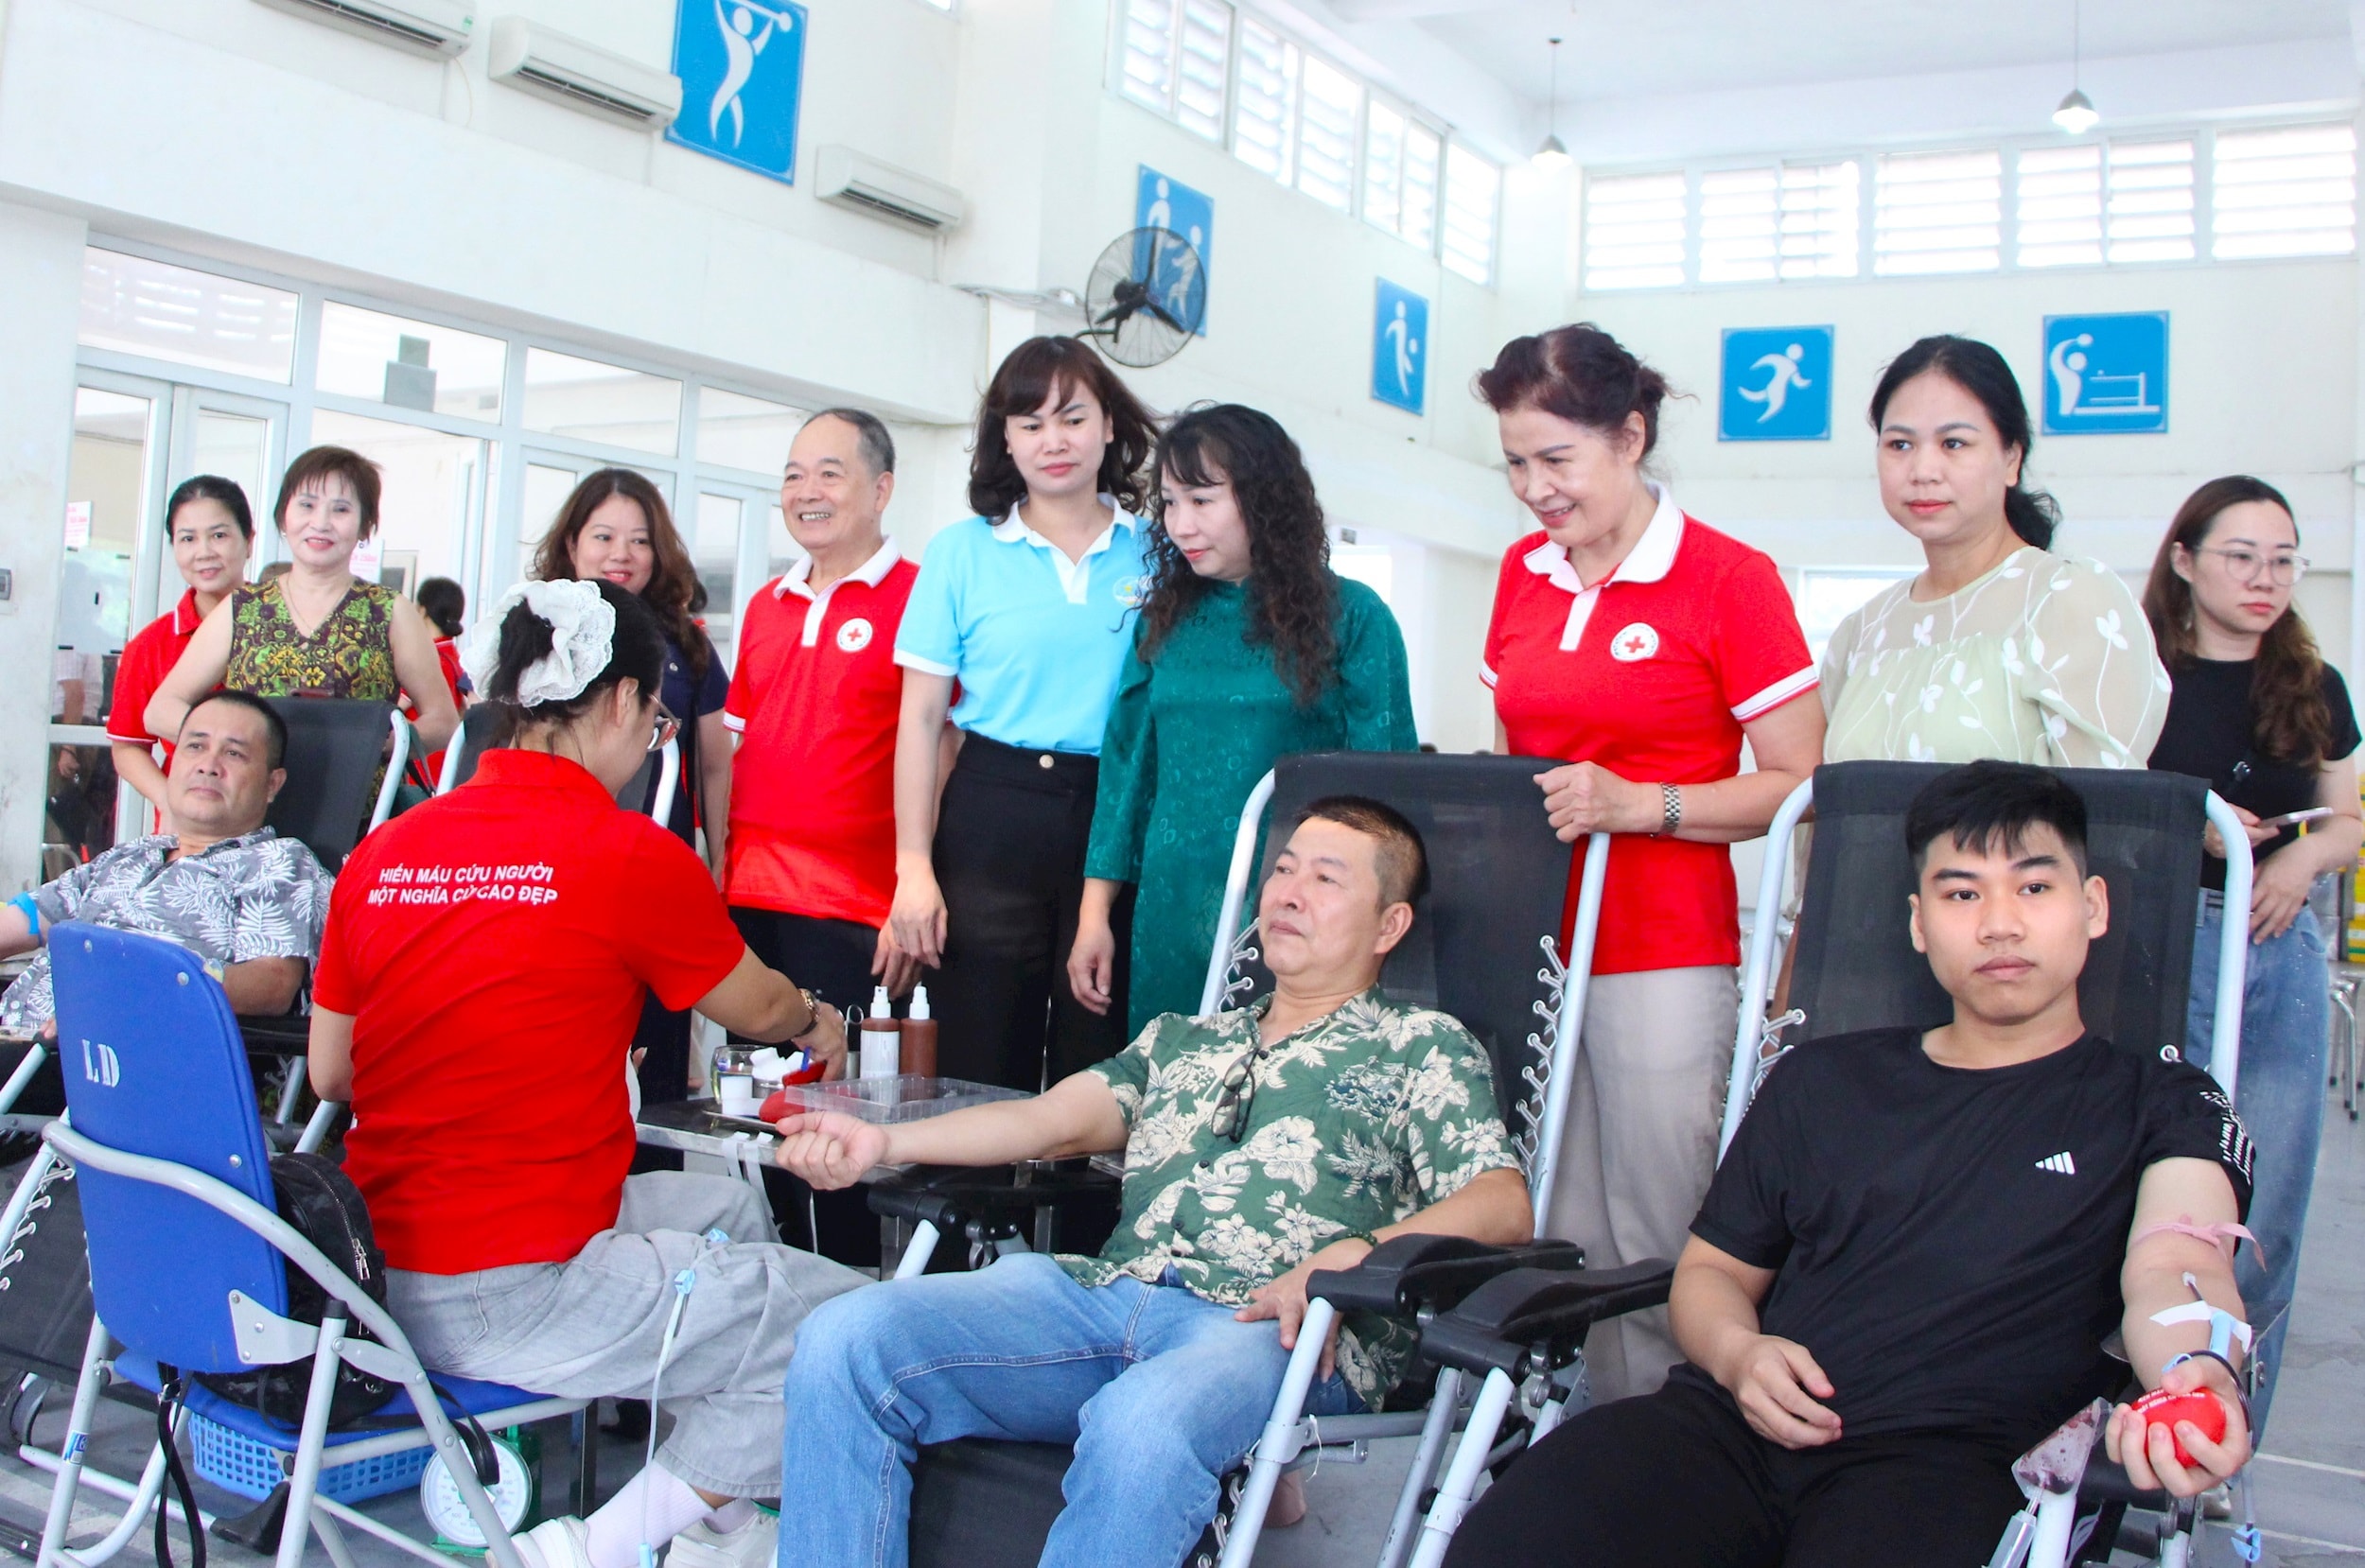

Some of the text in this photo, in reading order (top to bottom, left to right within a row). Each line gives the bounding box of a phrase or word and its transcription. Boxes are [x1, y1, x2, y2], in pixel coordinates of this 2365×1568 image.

[378, 862, 554, 883] HIẾN MÁU CỨU NGƯỜI
[367, 885, 397, 907] MỘT
[399, 885, 448, 904] NGHĨA
[476, 883, 515, 900] CAO
[518, 884, 558, 905] ĐẸP
[81, 1038, 120, 1088] LD
